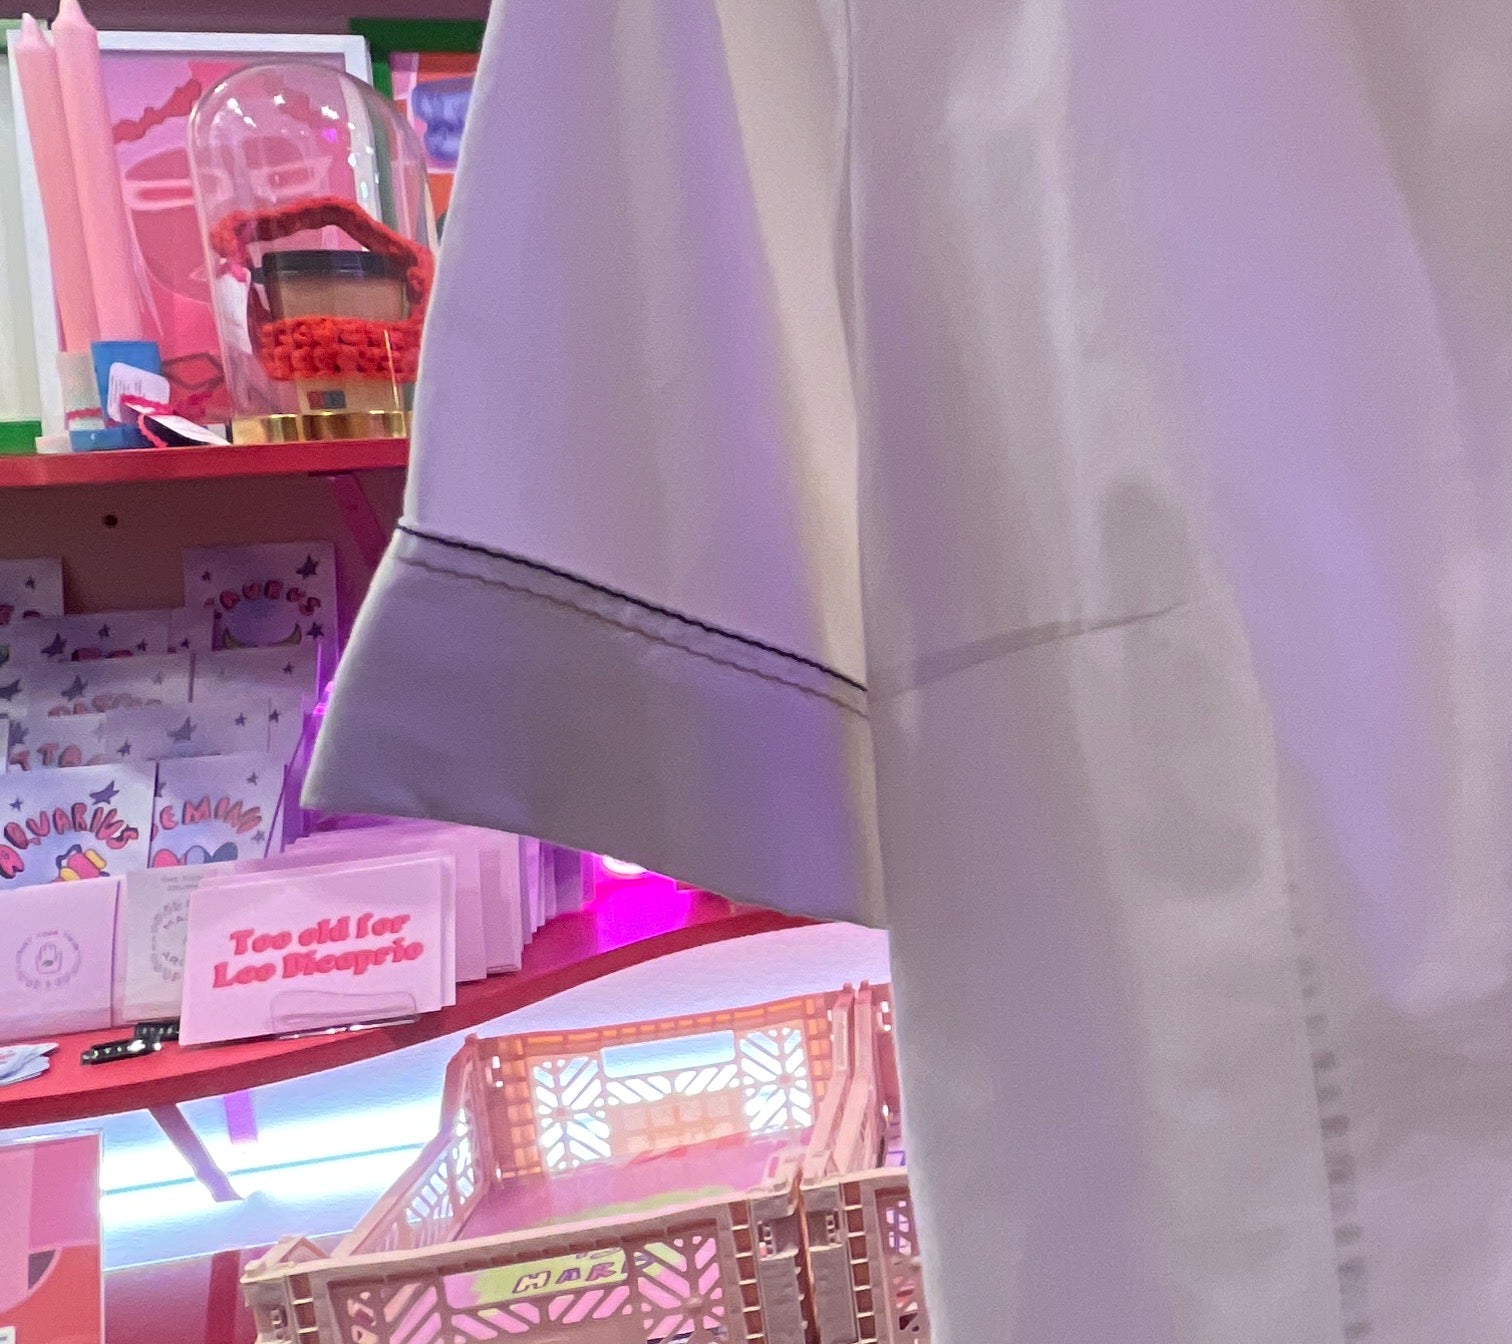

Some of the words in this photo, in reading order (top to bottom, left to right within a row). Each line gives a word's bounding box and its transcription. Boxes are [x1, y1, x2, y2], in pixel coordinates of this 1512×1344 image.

[0, 801, 139, 879] AQUARIUS
[151, 795, 263, 842] EMINI
[229, 928, 293, 956] Too
[298, 915, 351, 947] old
[355, 911, 412, 940] for
[212, 961, 277, 989] Leo
[281, 937, 424, 979] Dicaprio
